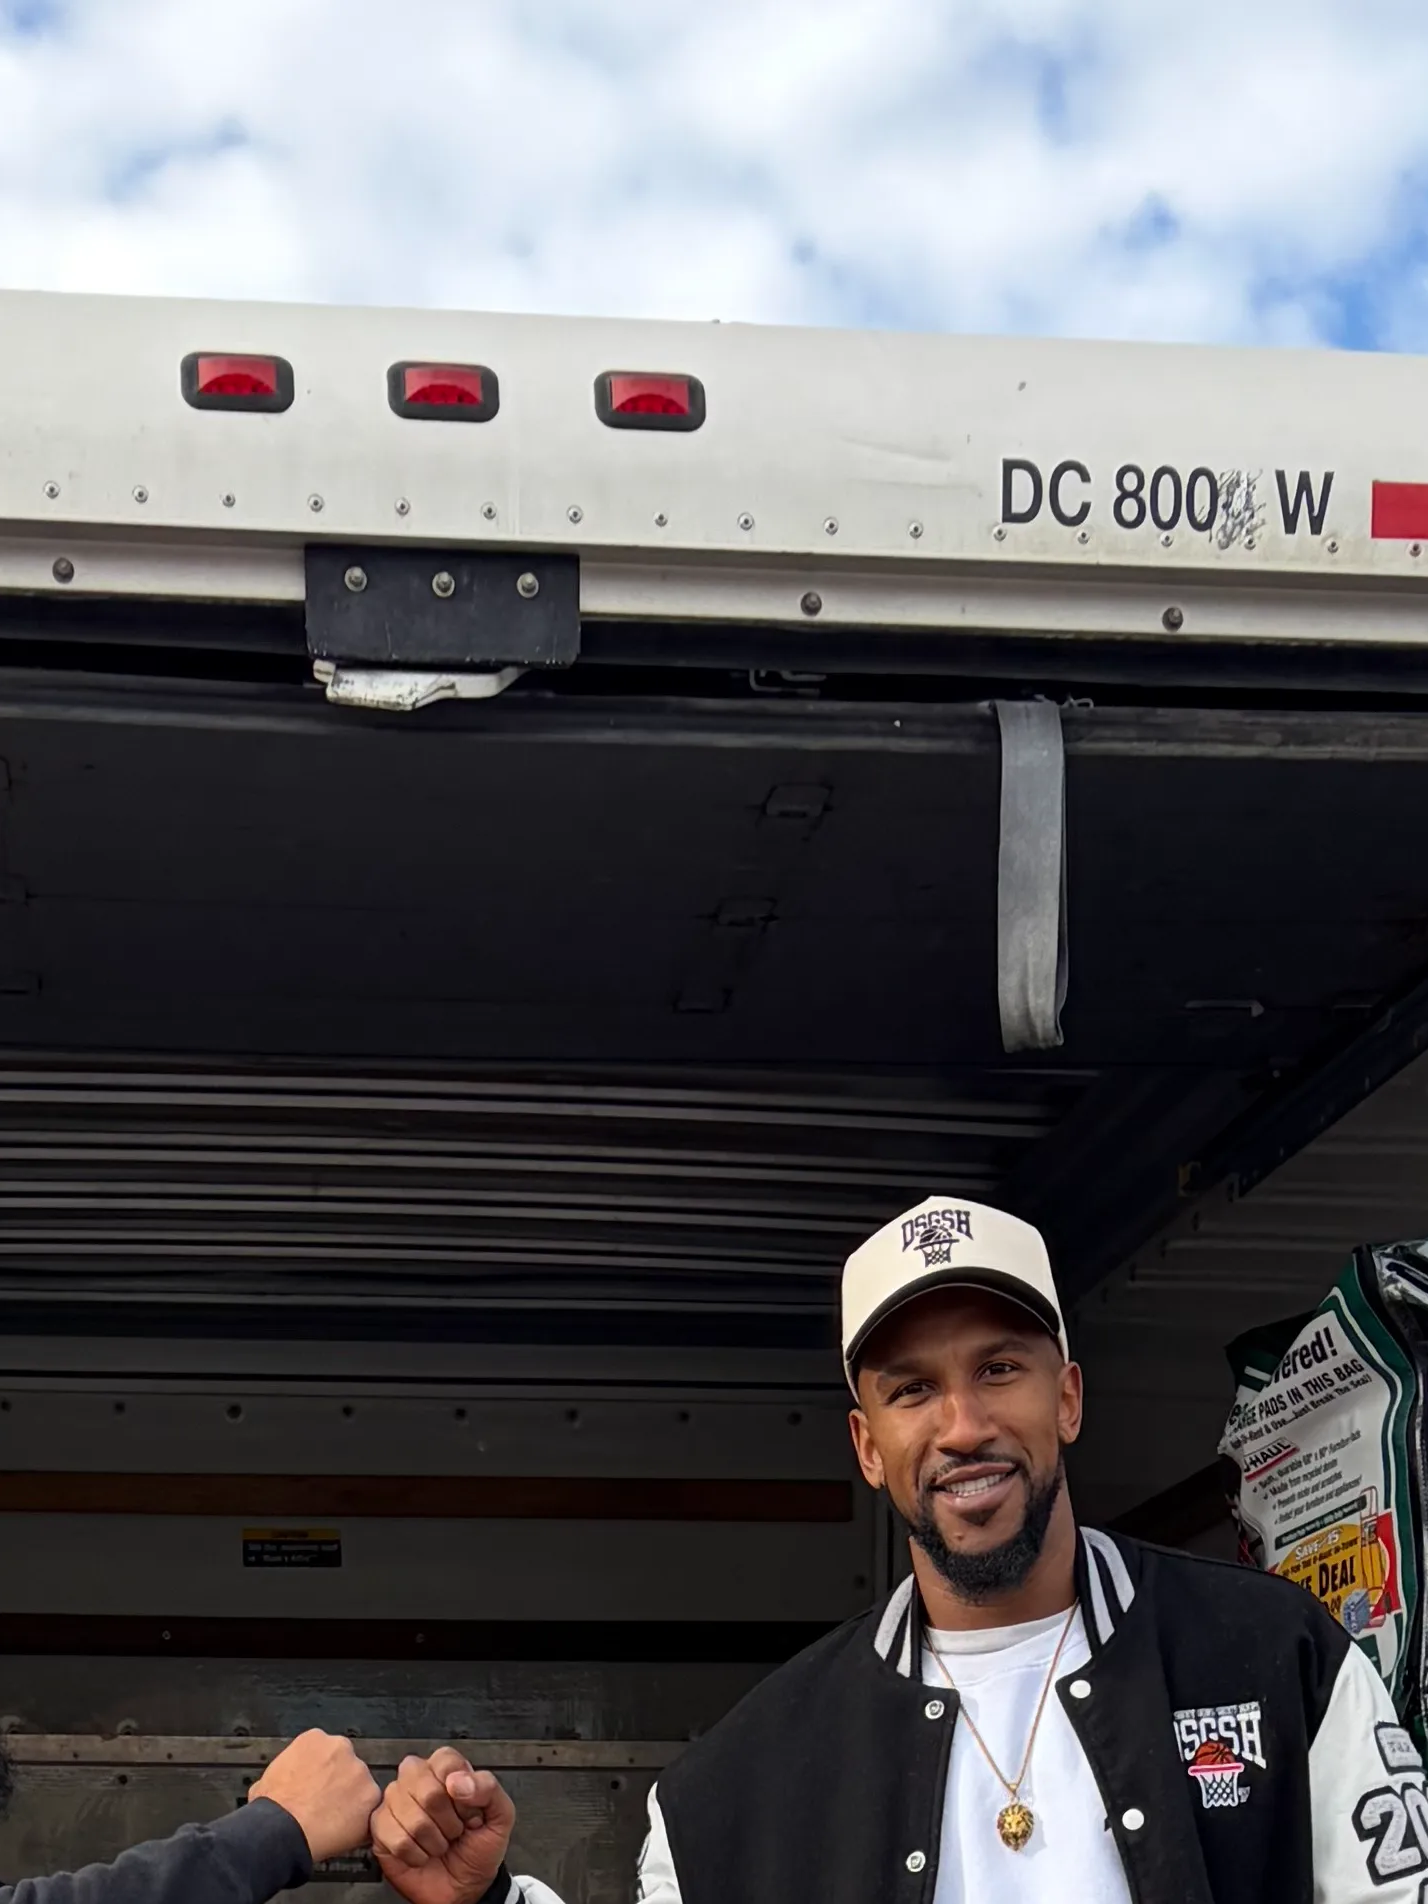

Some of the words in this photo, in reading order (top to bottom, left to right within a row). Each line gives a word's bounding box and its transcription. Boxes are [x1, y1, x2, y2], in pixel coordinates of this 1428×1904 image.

[1000, 459, 1091, 526] DC
[1112, 464, 1265, 548] 800
[1275, 470, 1333, 535] W
[1259, 1395, 1288, 1419] PADS
[1287, 1387, 1304, 1405] IN
[1303, 1373, 1335, 1396] THIS
[1333, 1359, 1364, 1381] BAG
[1319, 1556, 1355, 1597] DEAL
